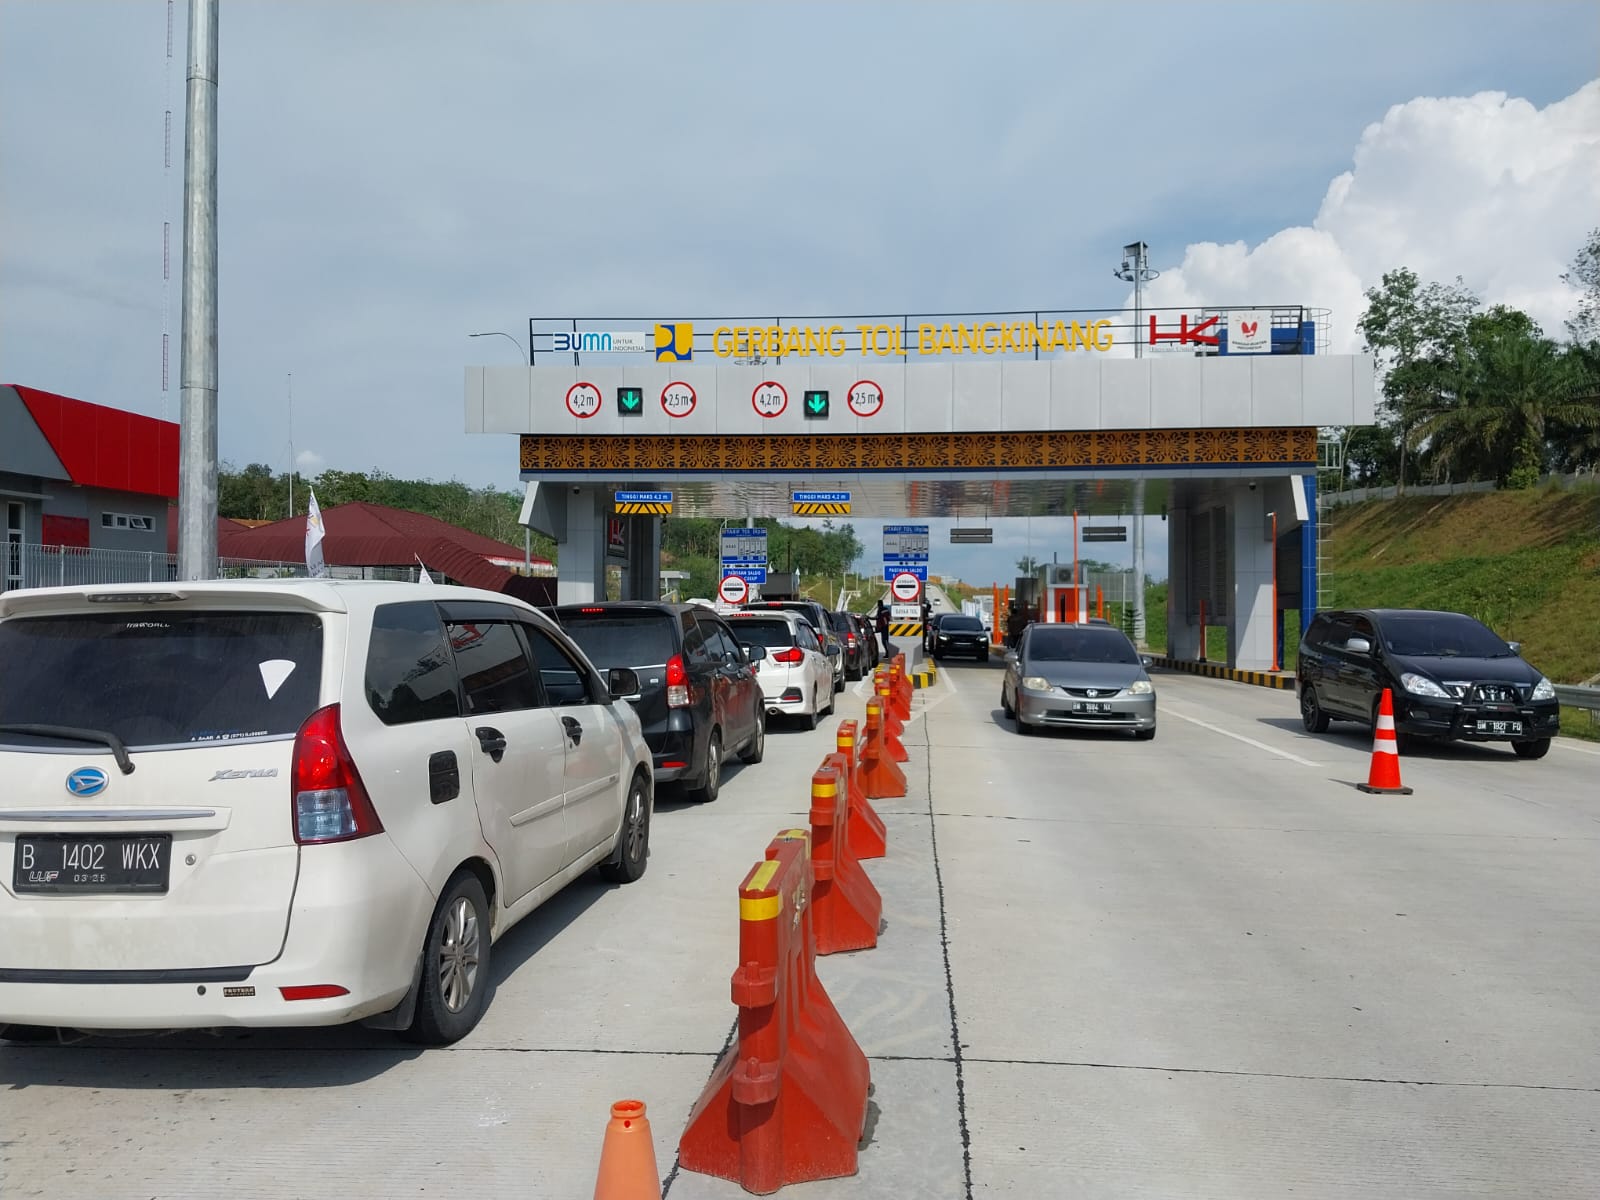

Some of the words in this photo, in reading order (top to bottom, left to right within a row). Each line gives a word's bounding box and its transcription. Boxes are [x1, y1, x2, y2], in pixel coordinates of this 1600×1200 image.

[1149, 314, 1219, 345] HK
[712, 325, 846, 358] GERBANG
[856, 324, 908, 357] TOL
[918, 319, 1113, 355] BANGKINANG
[573, 394, 585, 408] 4,2
[586, 396, 594, 407] m
[668, 394, 681, 408] 2,5
[681, 396, 689, 406] m
[759, 393, 771, 407] 4,2
[772, 395, 780, 405] m
[855, 392, 866, 406] 2,5
[867, 394, 876, 404] m
[22, 844, 35, 870] B
[62, 844, 105, 870] 1402
[122, 843, 161, 870] WKX
